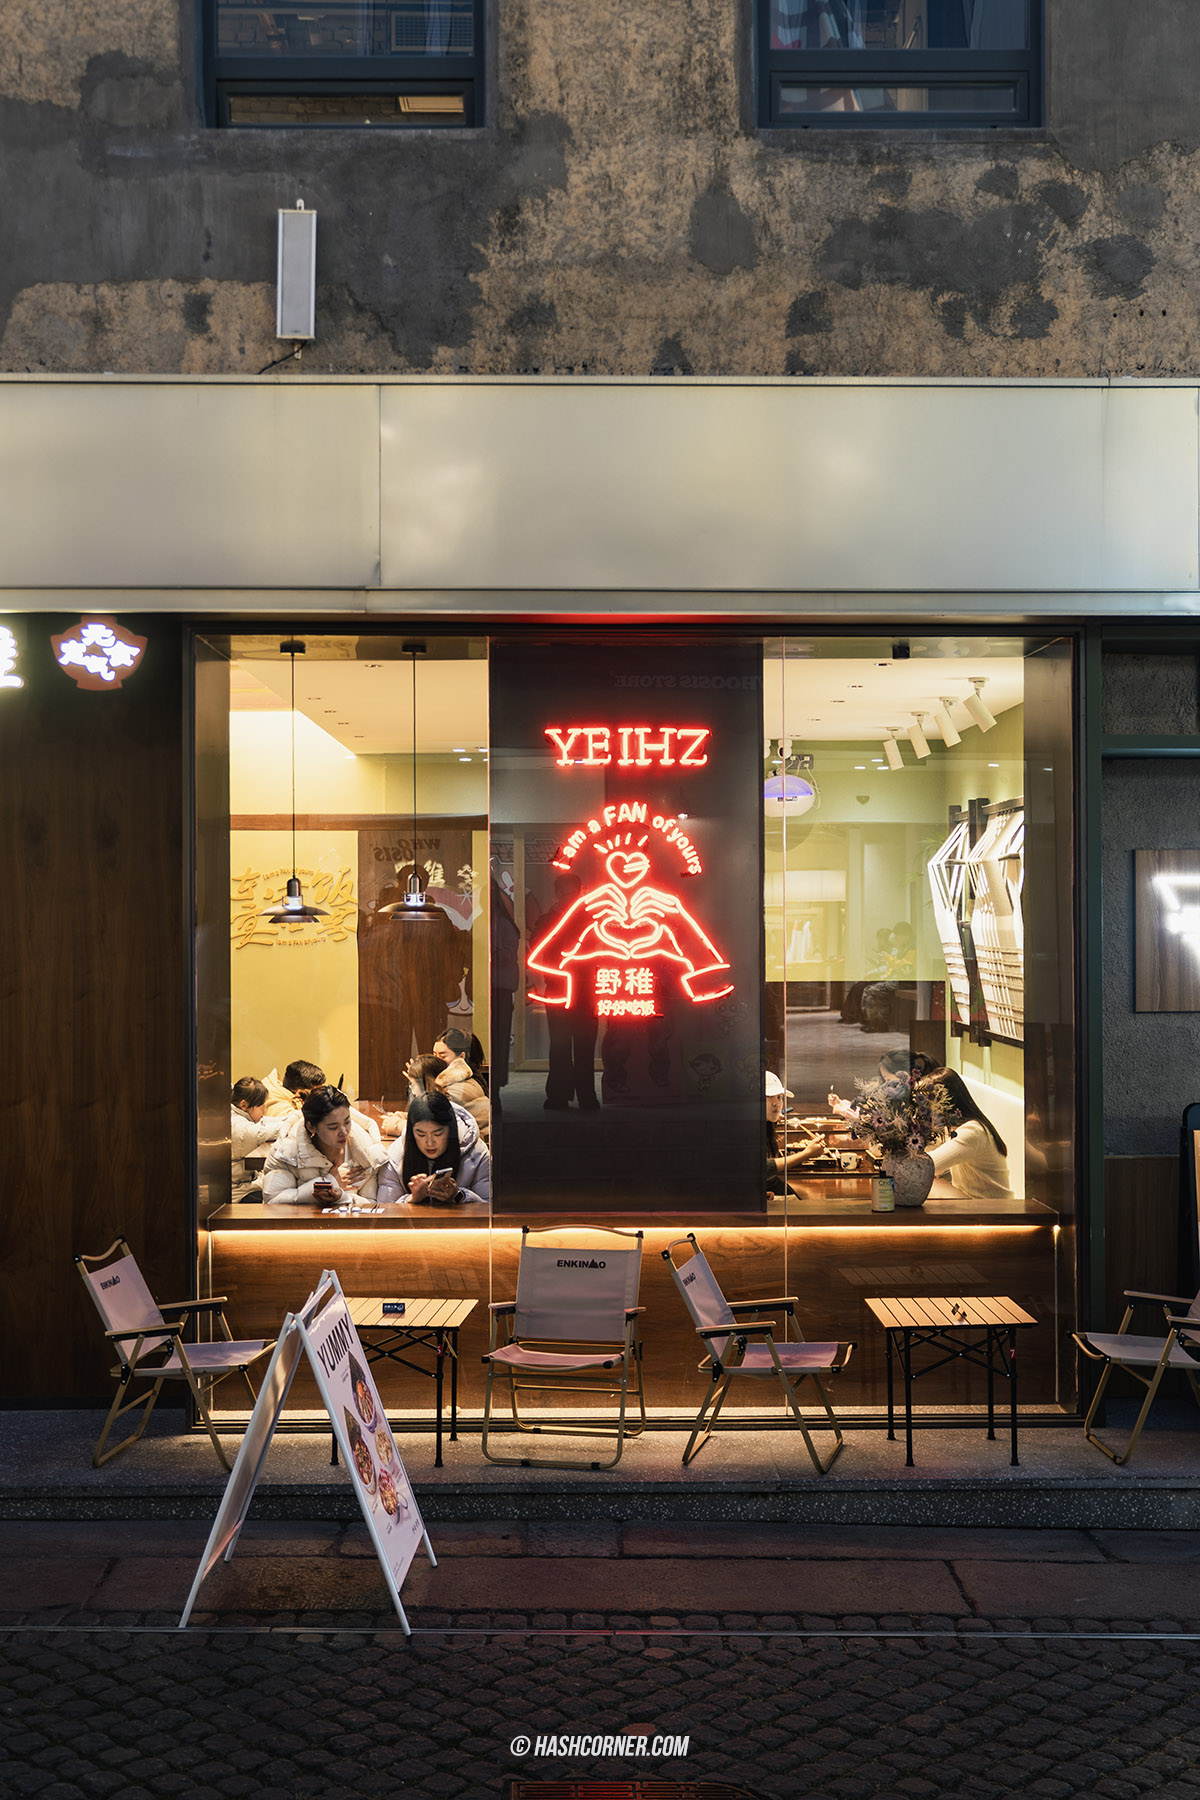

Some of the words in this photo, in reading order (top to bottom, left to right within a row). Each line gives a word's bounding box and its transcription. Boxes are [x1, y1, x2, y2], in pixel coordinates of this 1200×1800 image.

[563, 830, 587, 858] am
[587, 819, 602, 834] a
[603, 801, 648, 827] FAN
[595, 967, 654, 996] 野稚
[596, 999, 656, 1017] 好好吃饭
[316, 1312, 354, 1379] YUMMY
